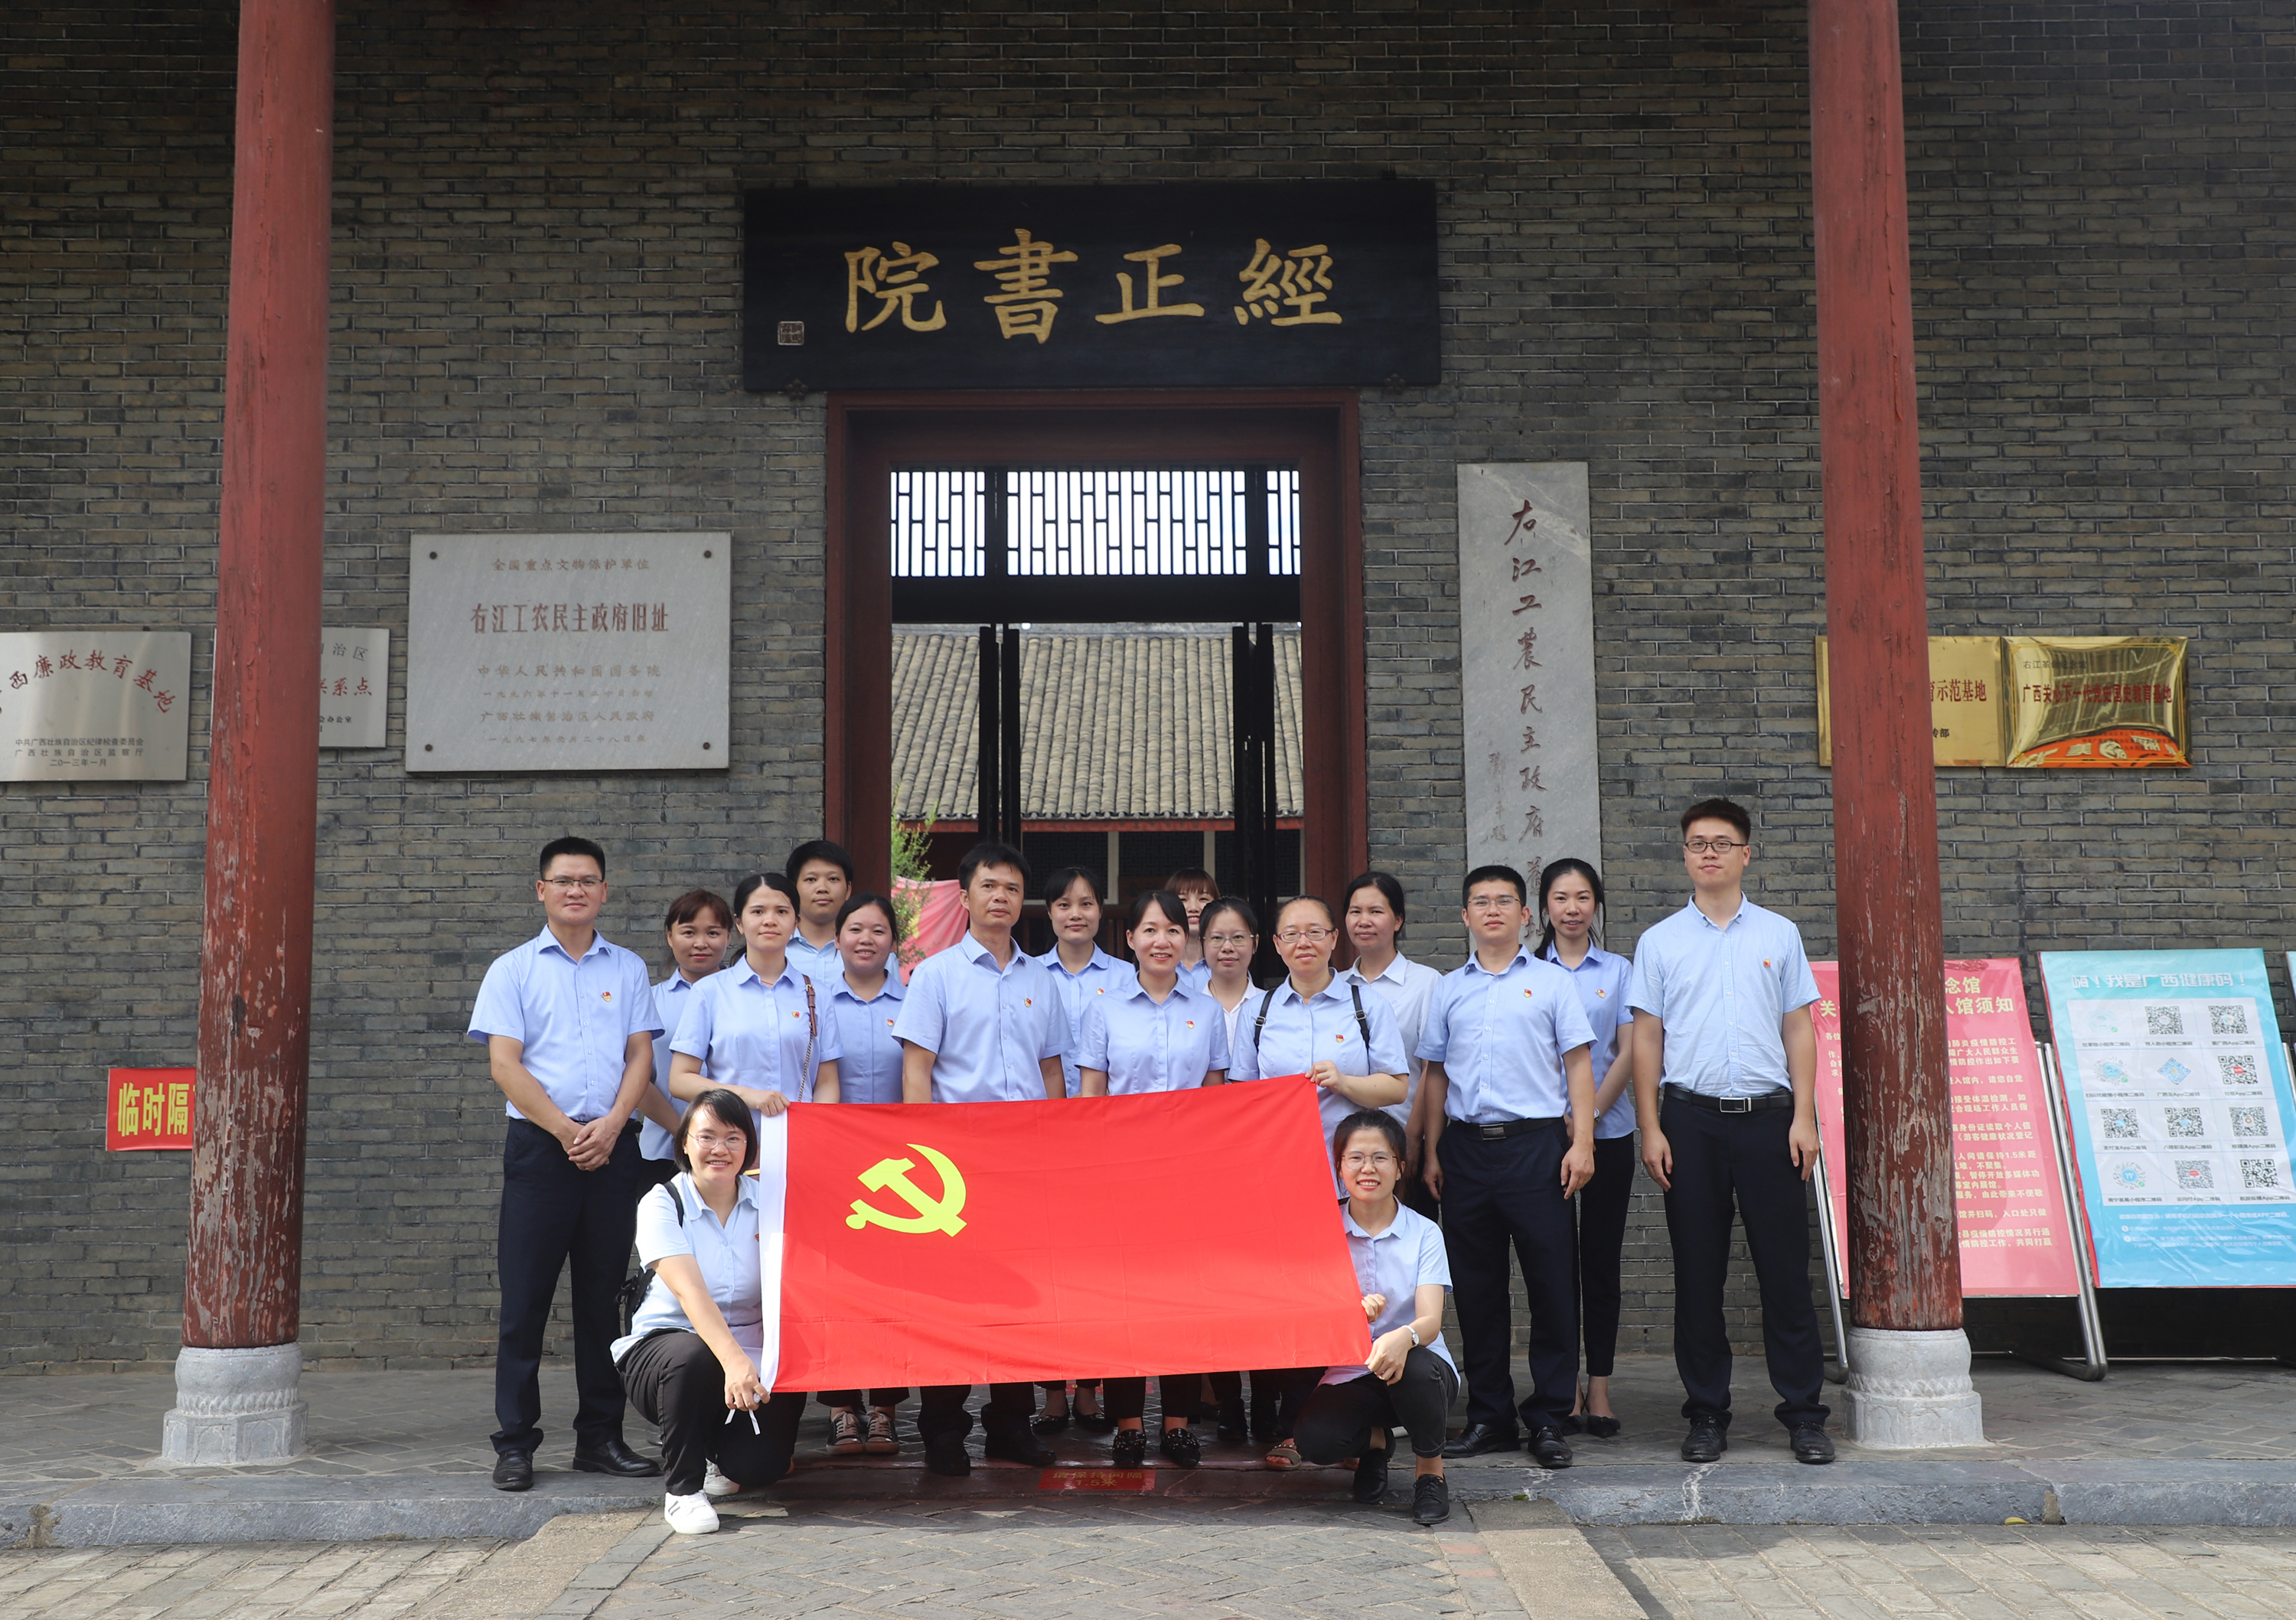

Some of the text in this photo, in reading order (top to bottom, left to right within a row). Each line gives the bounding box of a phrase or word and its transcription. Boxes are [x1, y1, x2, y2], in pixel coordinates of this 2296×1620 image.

[492, 558, 650, 572] 全国重点文物保护单位
[470, 602, 670, 634] 右江工农民主政府旧址
[321, 642, 368, 662] 治区
[478, 664, 661, 678] 中华人民共和国国务院
[0, 649, 176, 713] 西廉政教育基地
[480, 710, 656, 722] 广西壮族自治区人民政府
[15, 738, 144, 746] 中共广西壮族自治区纪律检查委员会
[15, 748, 144, 757] 广西壮族自治区监察厅
[1945, 976, 1981, 994] 念馆
[1951, 1094, 2027, 1103] 接受体温检测。如
[117, 1082, 190, 1137] 临时隔
[1075, 1478, 1117, 1487] 1.5米
